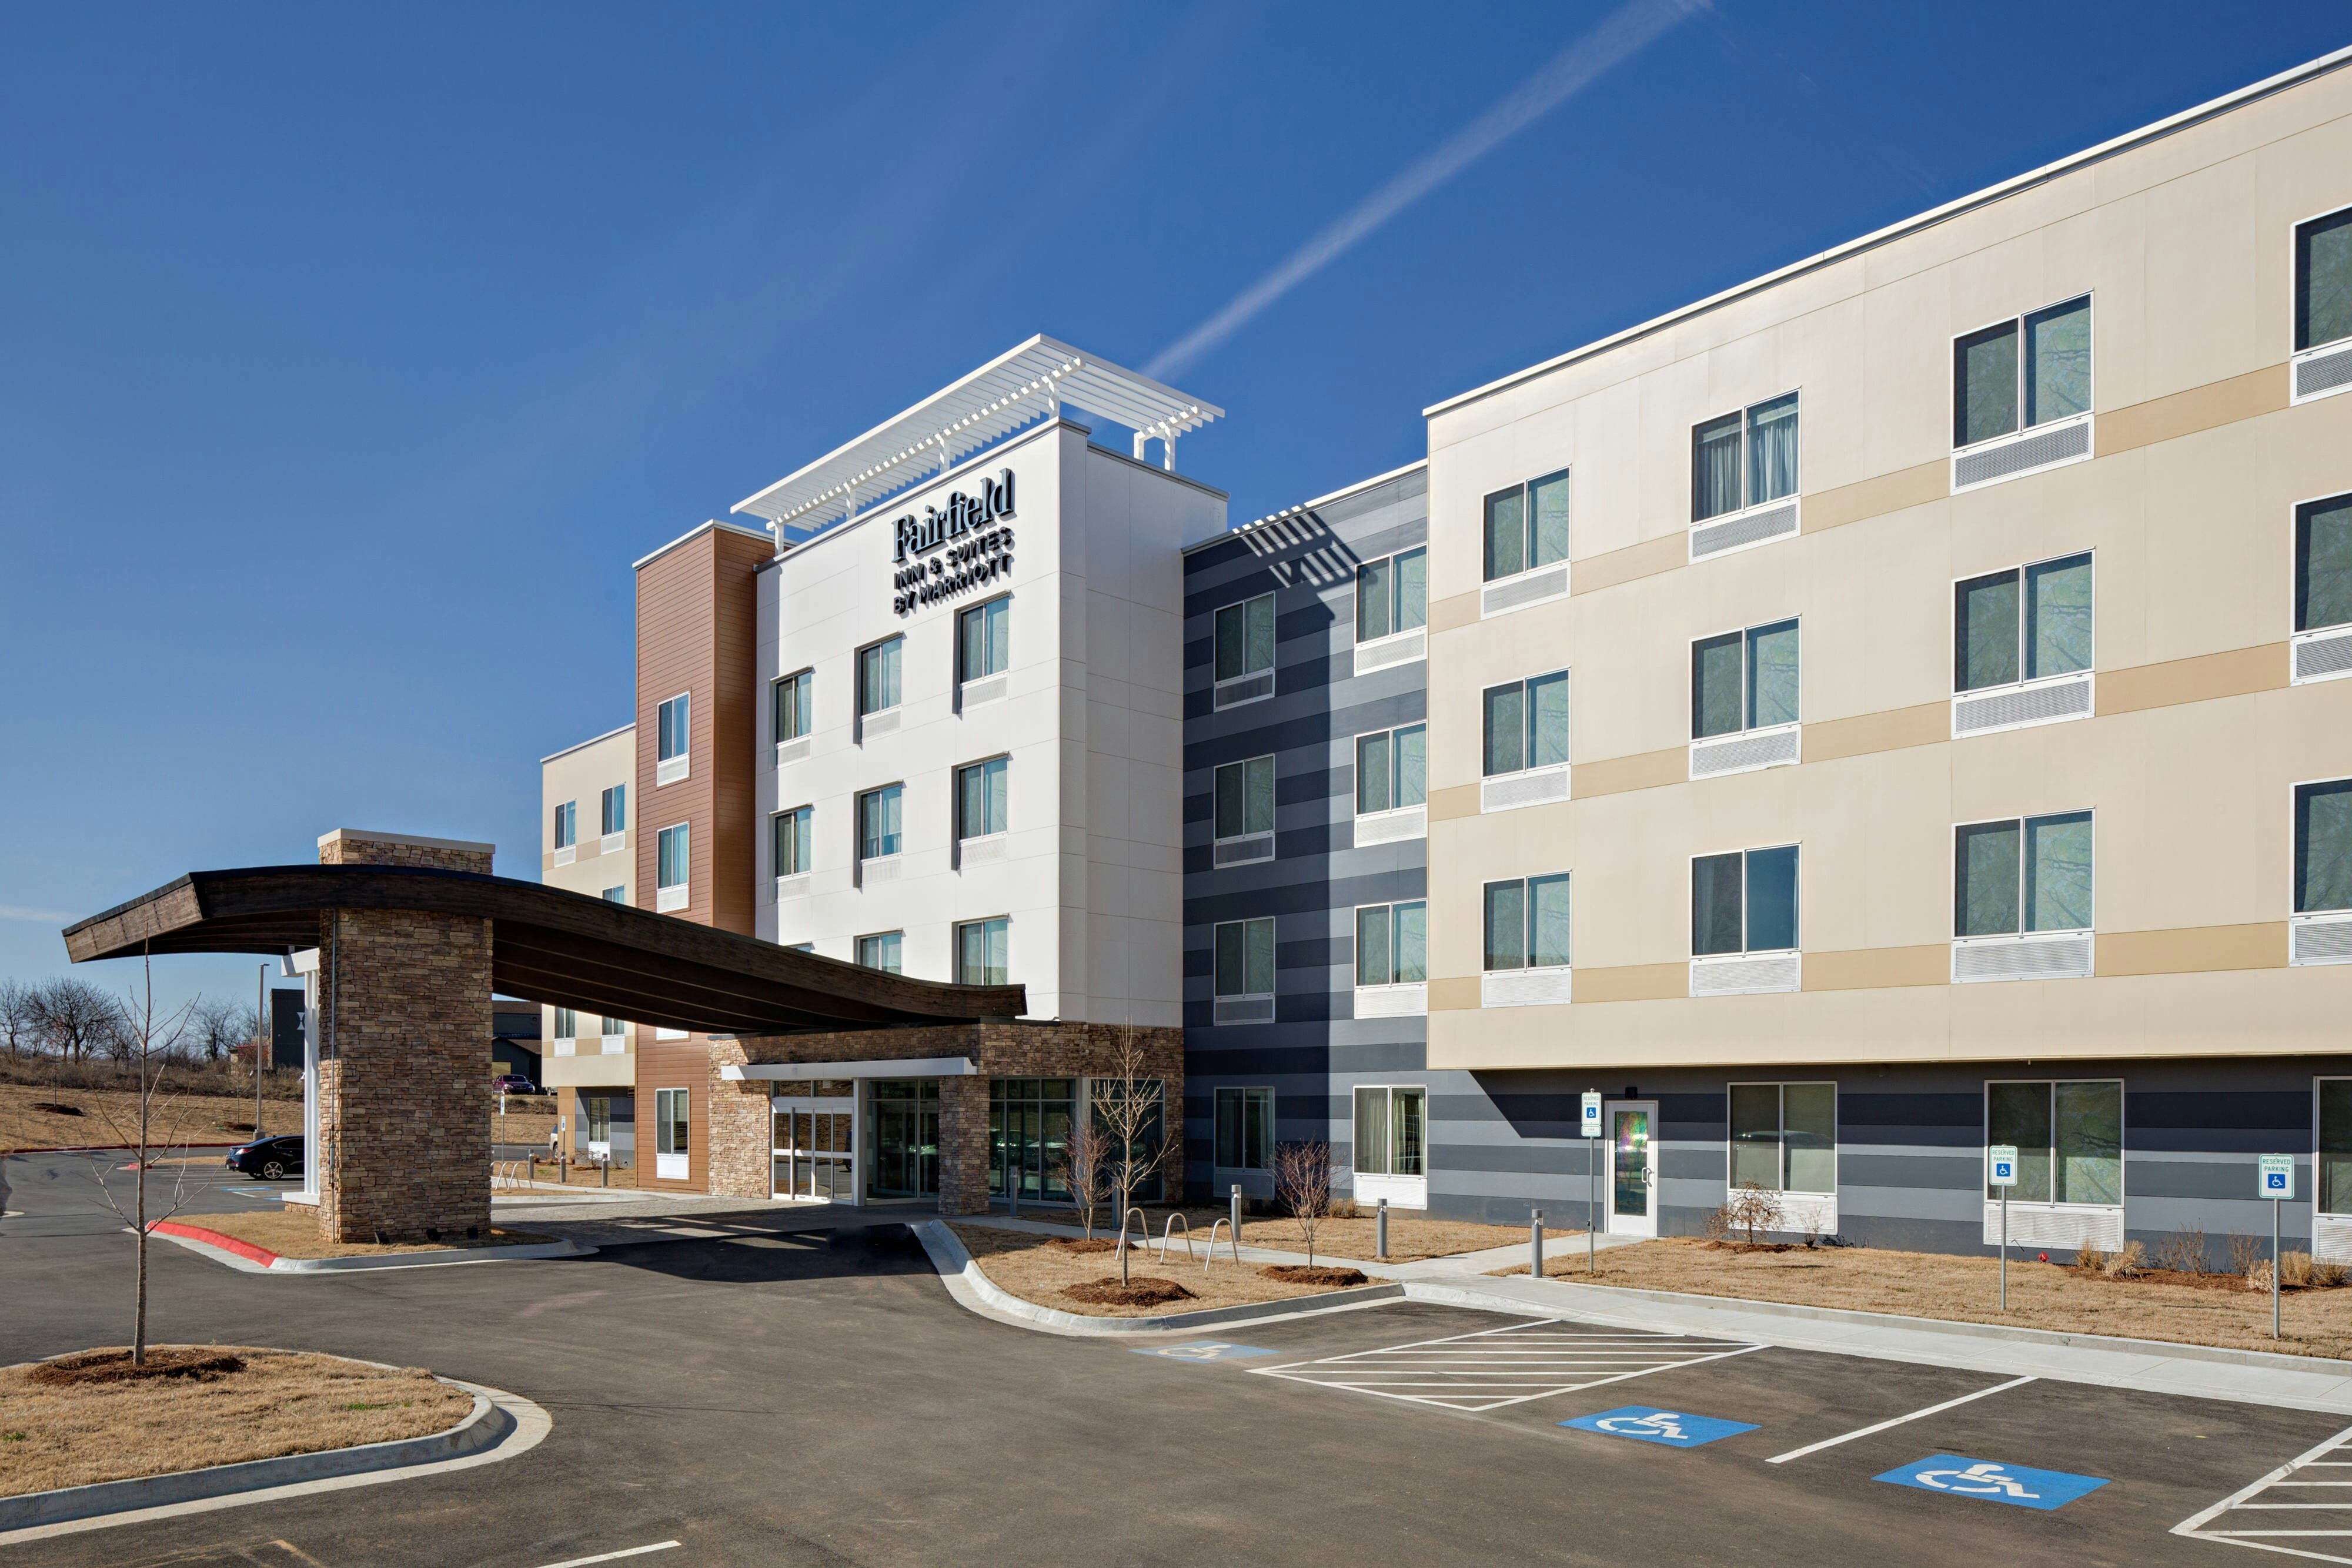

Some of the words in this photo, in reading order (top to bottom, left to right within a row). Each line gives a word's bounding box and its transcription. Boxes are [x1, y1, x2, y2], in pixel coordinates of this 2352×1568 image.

[891, 467, 1015, 563] Fairfield
[894, 563, 926, 589] INN
[928, 557, 942, 574] &
[946, 526, 1014, 567] SUITES
[894, 590, 916, 614] BY
[919, 553, 1012, 604] MARRIOTT
